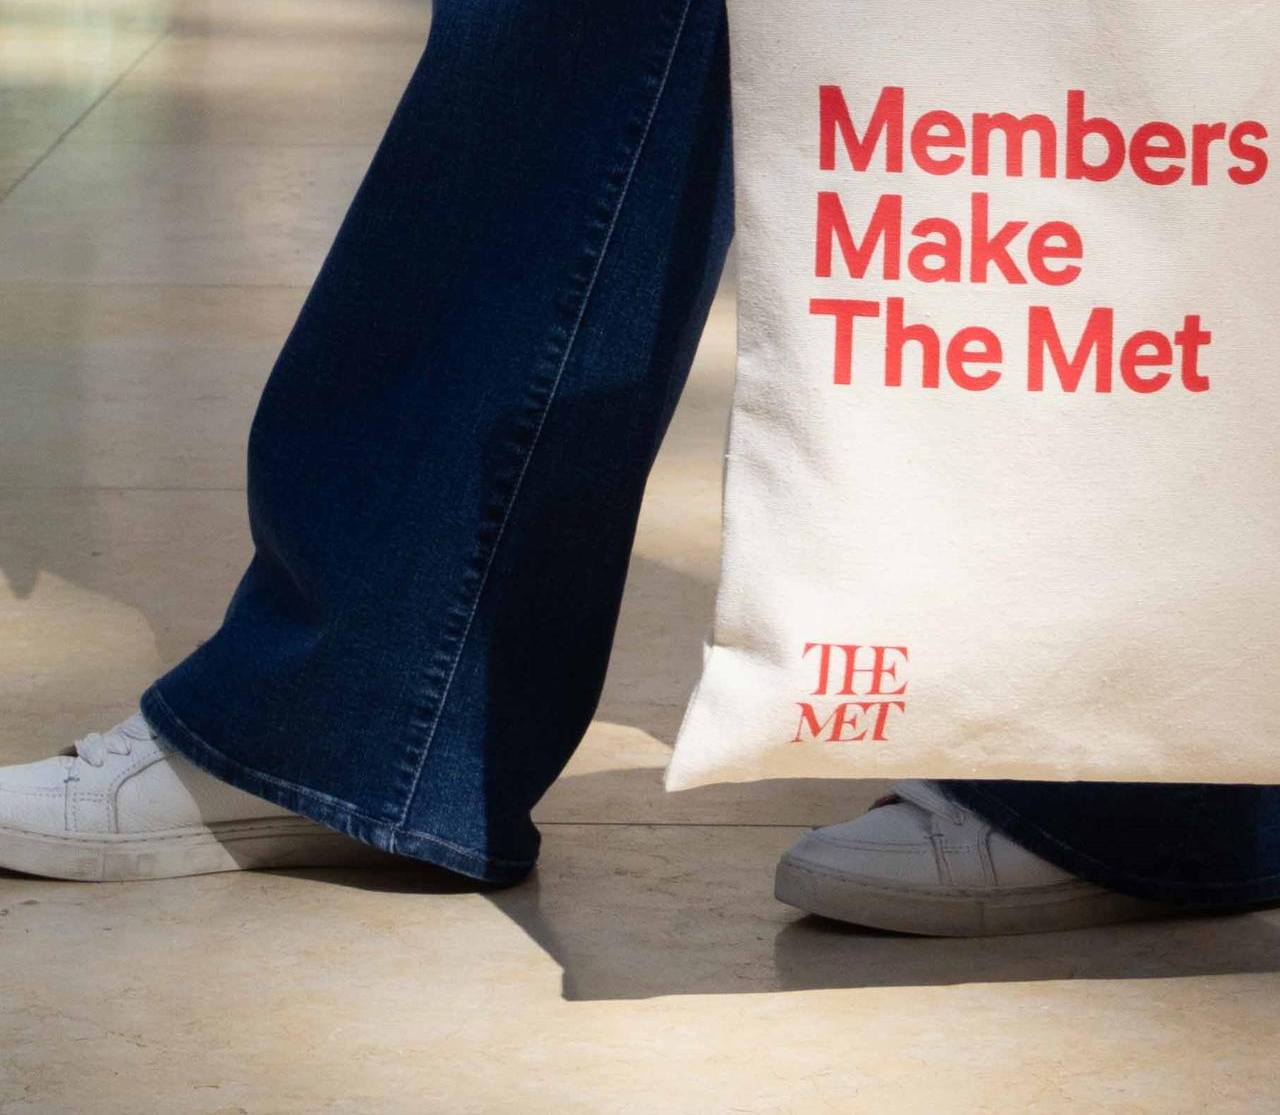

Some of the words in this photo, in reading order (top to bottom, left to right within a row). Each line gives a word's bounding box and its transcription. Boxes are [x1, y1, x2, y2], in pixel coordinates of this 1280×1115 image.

[818, 84, 1269, 187] Members
[815, 190, 1084, 287] Make
[808, 296, 1004, 392] The
[1026, 305, 1213, 395] Met
[802, 642, 908, 696] THE
[790, 700, 906, 743] MET
